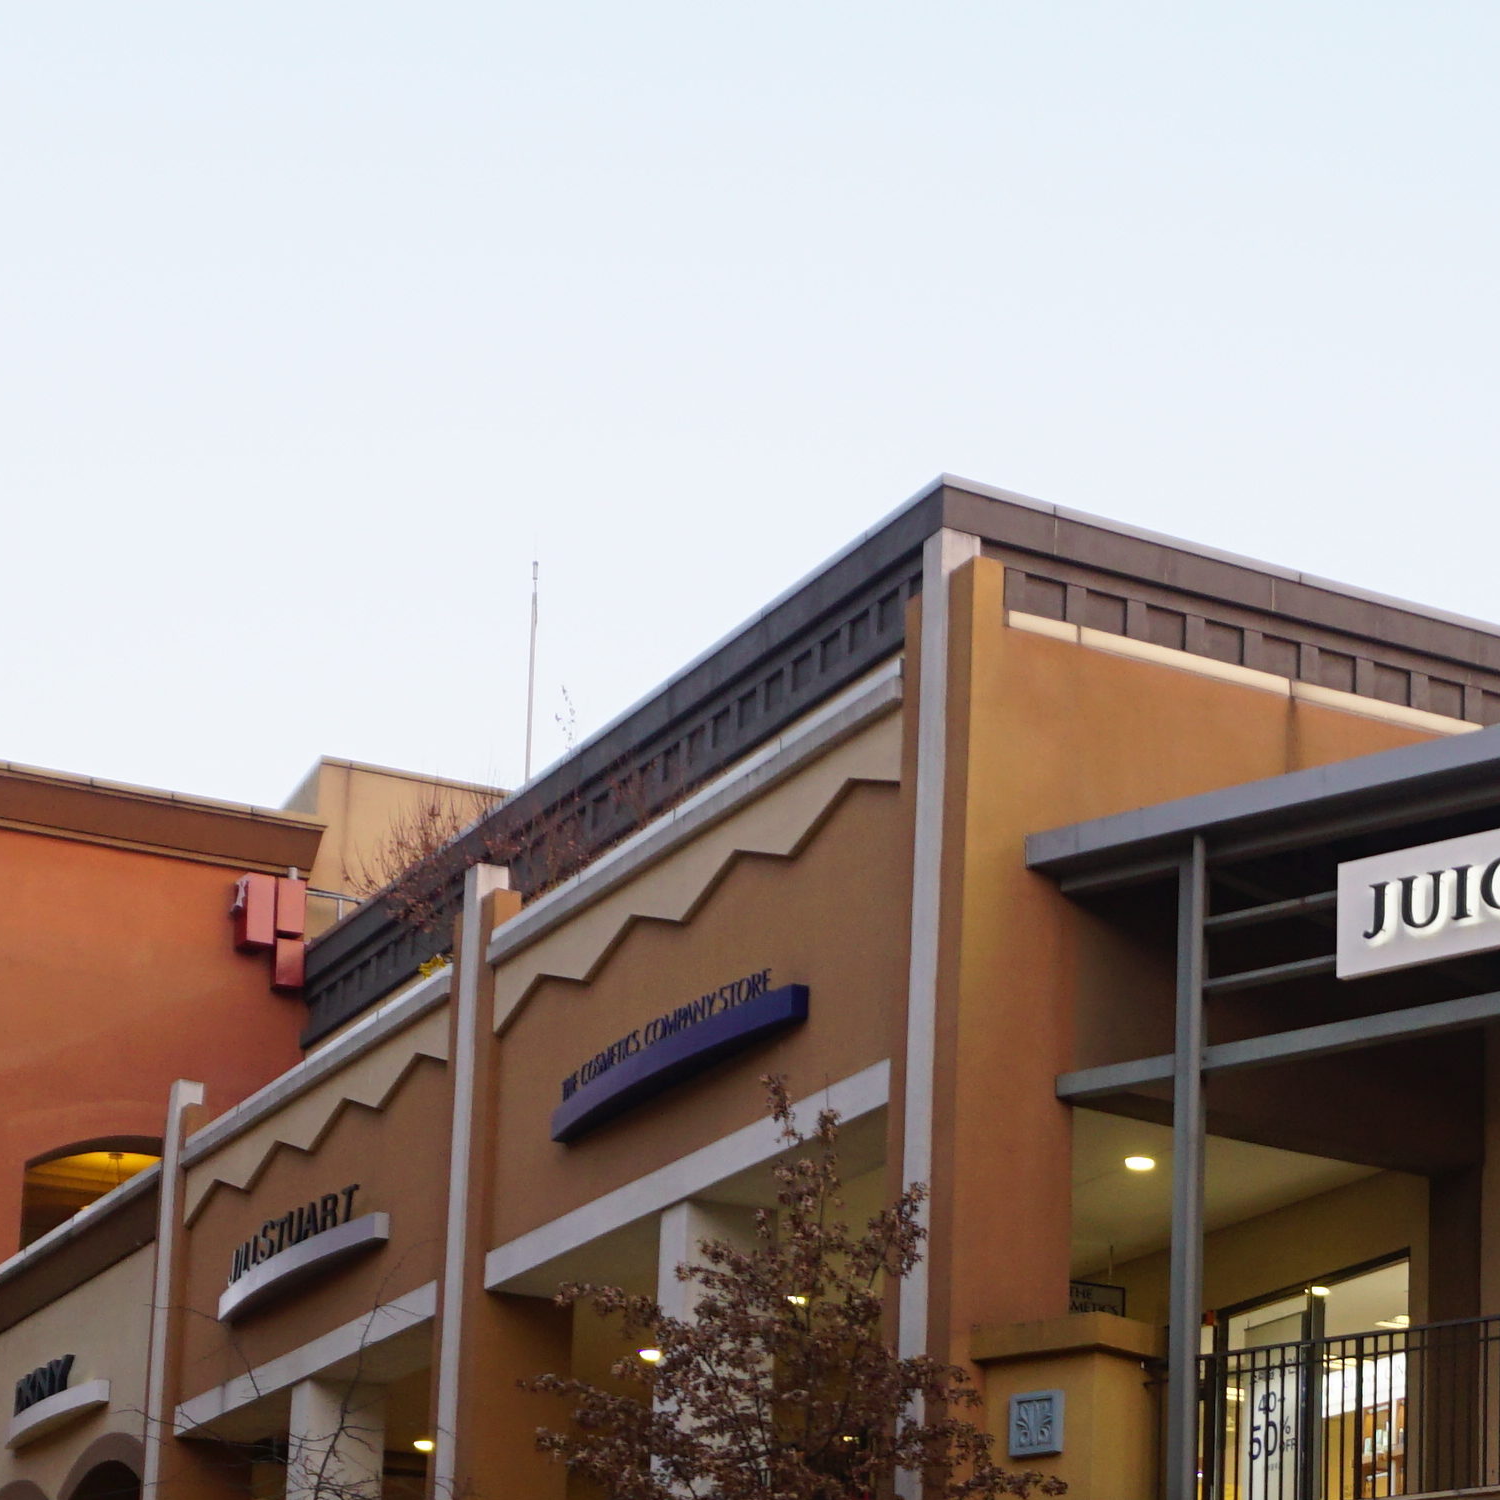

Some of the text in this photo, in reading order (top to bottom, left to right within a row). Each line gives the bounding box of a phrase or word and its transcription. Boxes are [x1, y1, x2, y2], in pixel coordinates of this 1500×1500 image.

[561, 968, 772, 1102] THE COSMETICS COMPANY STORE
[13, 1353, 76, 1418] DKNY
